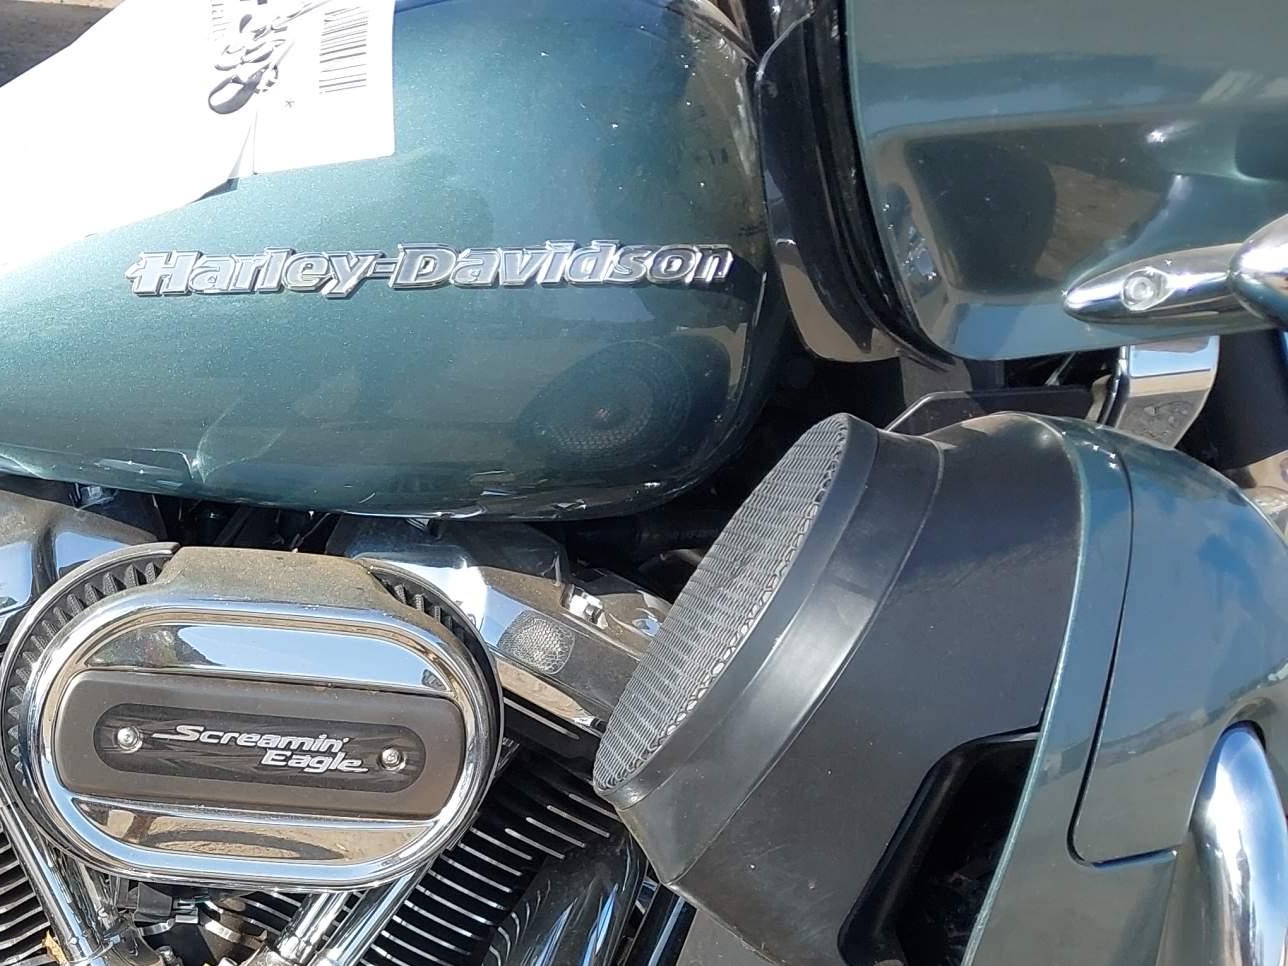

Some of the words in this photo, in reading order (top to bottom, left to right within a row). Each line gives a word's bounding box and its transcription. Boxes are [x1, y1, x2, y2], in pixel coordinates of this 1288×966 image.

[125, 240, 736, 298] Harley-Davidson
[152, 724, 350, 752] Screamin'
[261, 749, 369, 773] Eagle
